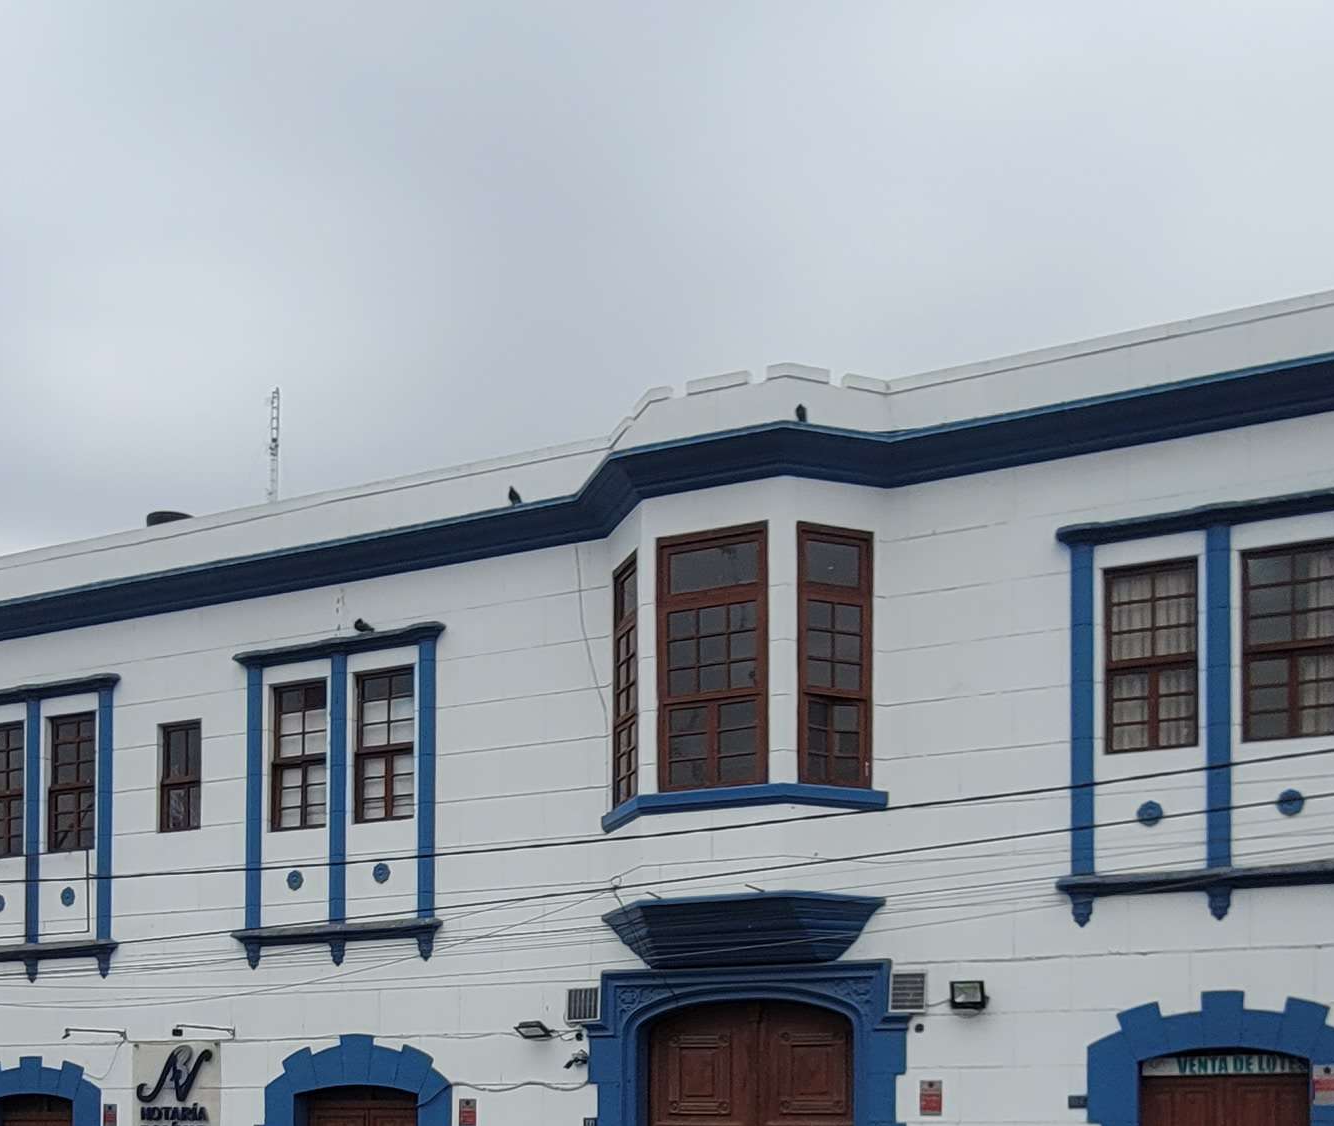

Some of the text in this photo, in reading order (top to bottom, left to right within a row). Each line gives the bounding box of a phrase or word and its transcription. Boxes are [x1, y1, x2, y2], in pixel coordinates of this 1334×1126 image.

[1177, 1055, 1308, 1075] VENTA DE LOTES
[140, 1103, 209, 1121] NOTARÍA
